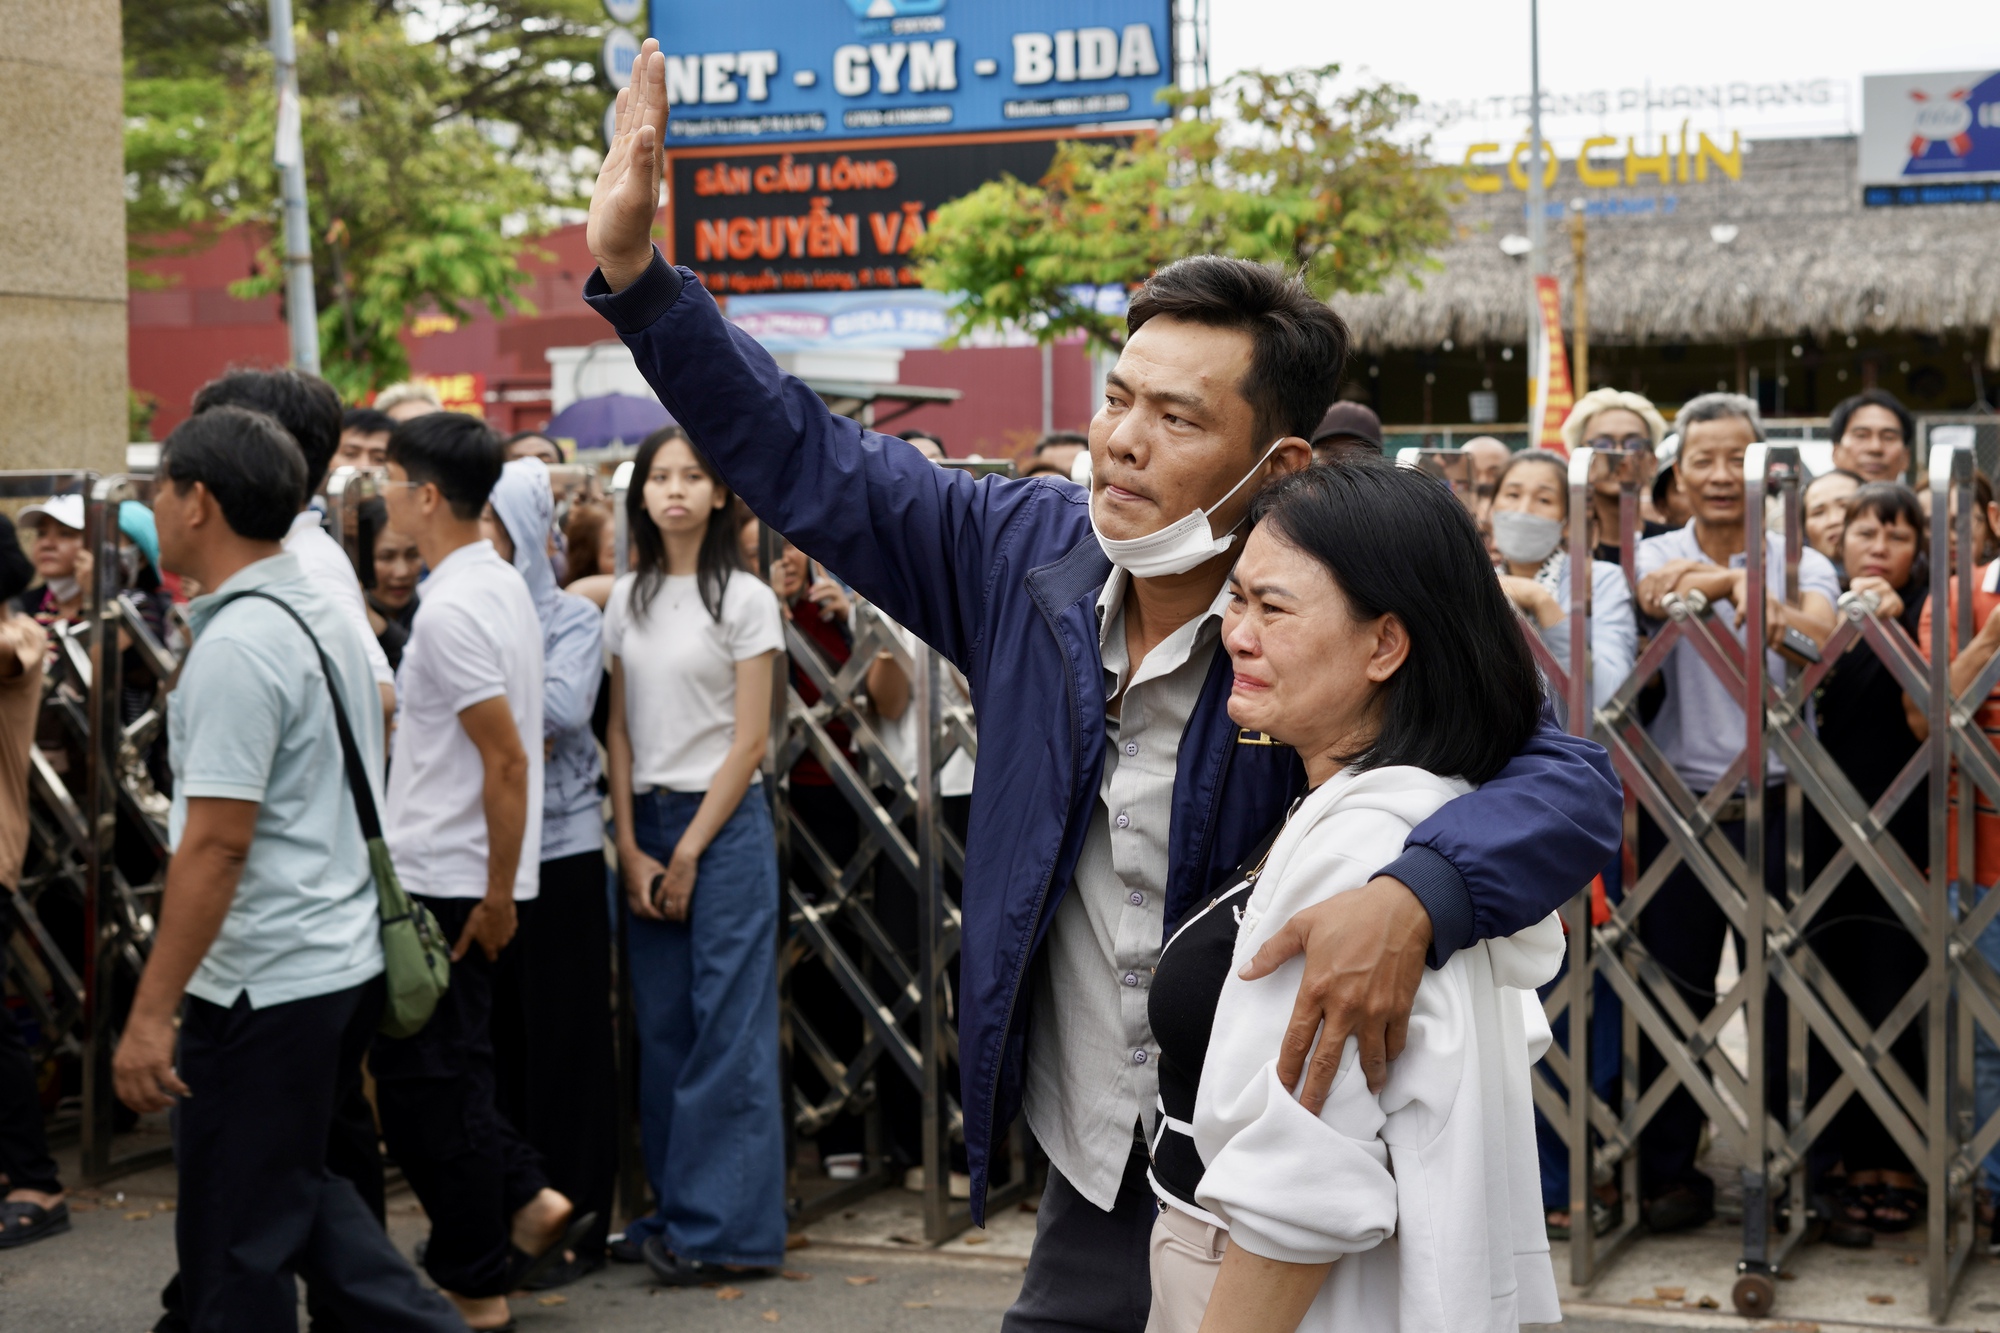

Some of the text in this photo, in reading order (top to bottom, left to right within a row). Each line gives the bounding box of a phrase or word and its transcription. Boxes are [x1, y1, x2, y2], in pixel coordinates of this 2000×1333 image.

[666, 49, 778, 104] NET
[833, 39, 957, 97] GYM
[1013, 24, 1160, 85] BIDA
[817, 155, 898, 191] LÔNG
[1576, 117, 1742, 188] CHÍN
[695, 196, 940, 262] NGUYỄN VĂ
